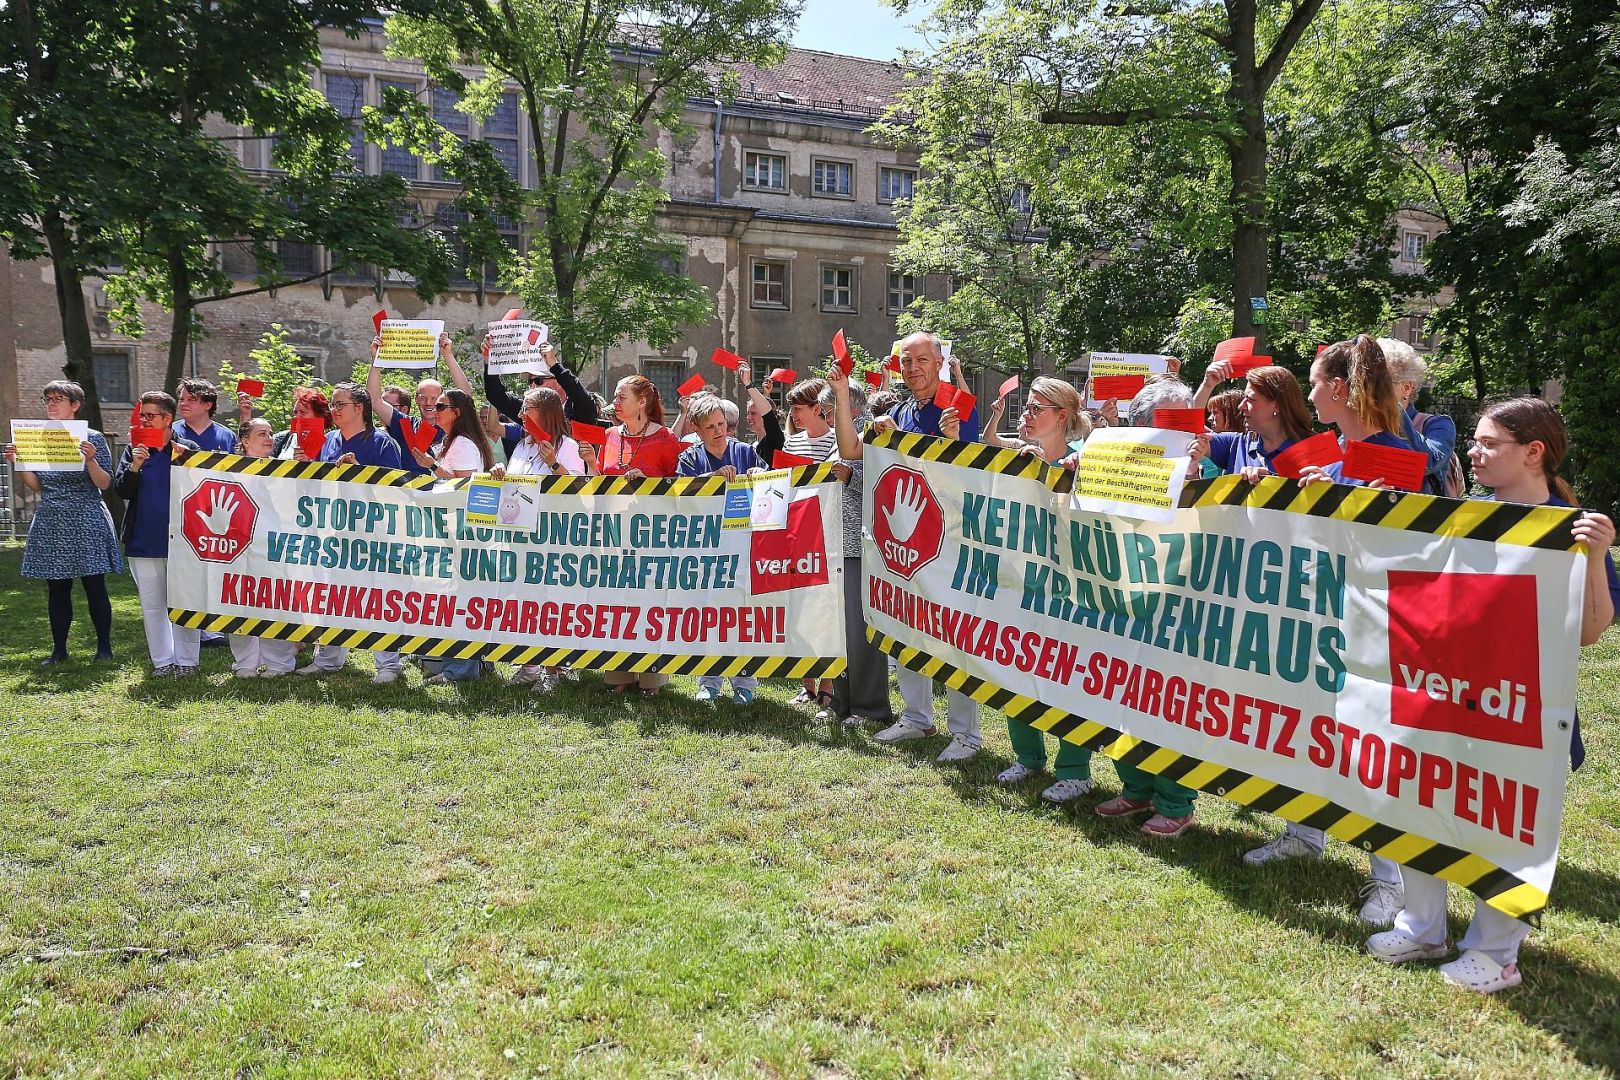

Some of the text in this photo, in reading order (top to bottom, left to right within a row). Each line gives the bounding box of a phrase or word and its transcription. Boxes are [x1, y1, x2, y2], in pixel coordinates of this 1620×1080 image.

[1131, 446, 1165, 457] geplante
[1094, 477, 1105, 485] der
[1106, 478, 1152, 491] Beschäftigten
[1153, 486, 1169, 494] und
[1102, 466, 1120, 474] Keine
[1120, 467, 1160, 481] Sparpakete
[1122, 492, 1173, 507] Krankenhaus!
[296, 495, 399, 536] STOPPT
[405, 505, 448, 539] DIE
[630, 513, 723, 549] GEGEN
[198, 535, 238, 555] STOP
[267, 530, 740, 591] VERSICHERTE UND BESCHÄFTIGTE!
[755, 552, 820, 576] ver.di
[884, 539, 919, 569] STOP
[962, 491, 1346, 620] KEINE KÜRZUNGEN
[220, 572, 786, 643] KRANKENKASSEN-SPARGESETZ STOPPEN!
[950, 543, 1347, 694] IM KRANKENHAUS
[869, 575, 1540, 846] KRANKENKASSEN-SPARGESETZ STOPPEN!
[1398, 663, 1527, 724] ver.di
